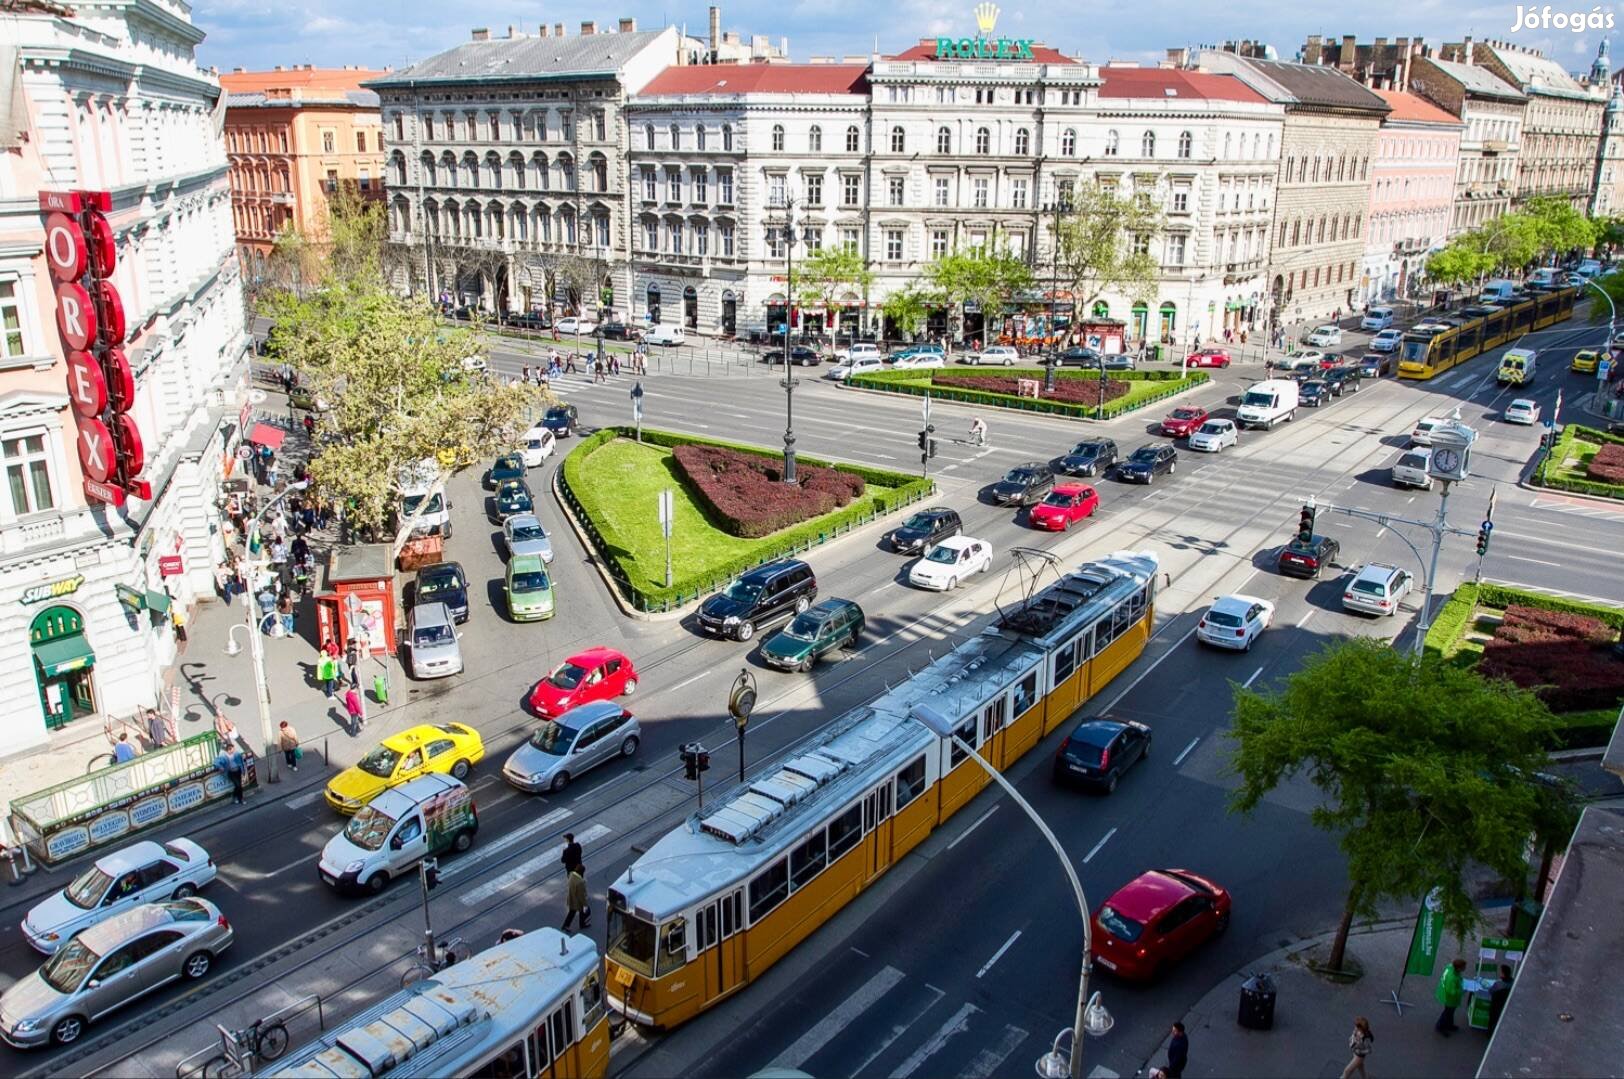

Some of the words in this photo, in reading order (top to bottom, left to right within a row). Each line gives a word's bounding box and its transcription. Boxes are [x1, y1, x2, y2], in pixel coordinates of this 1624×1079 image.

[936, 36, 1034, 59] ROLEX
[49, 225, 104, 471] OREX
[21, 576, 85, 604] SUBWAY
